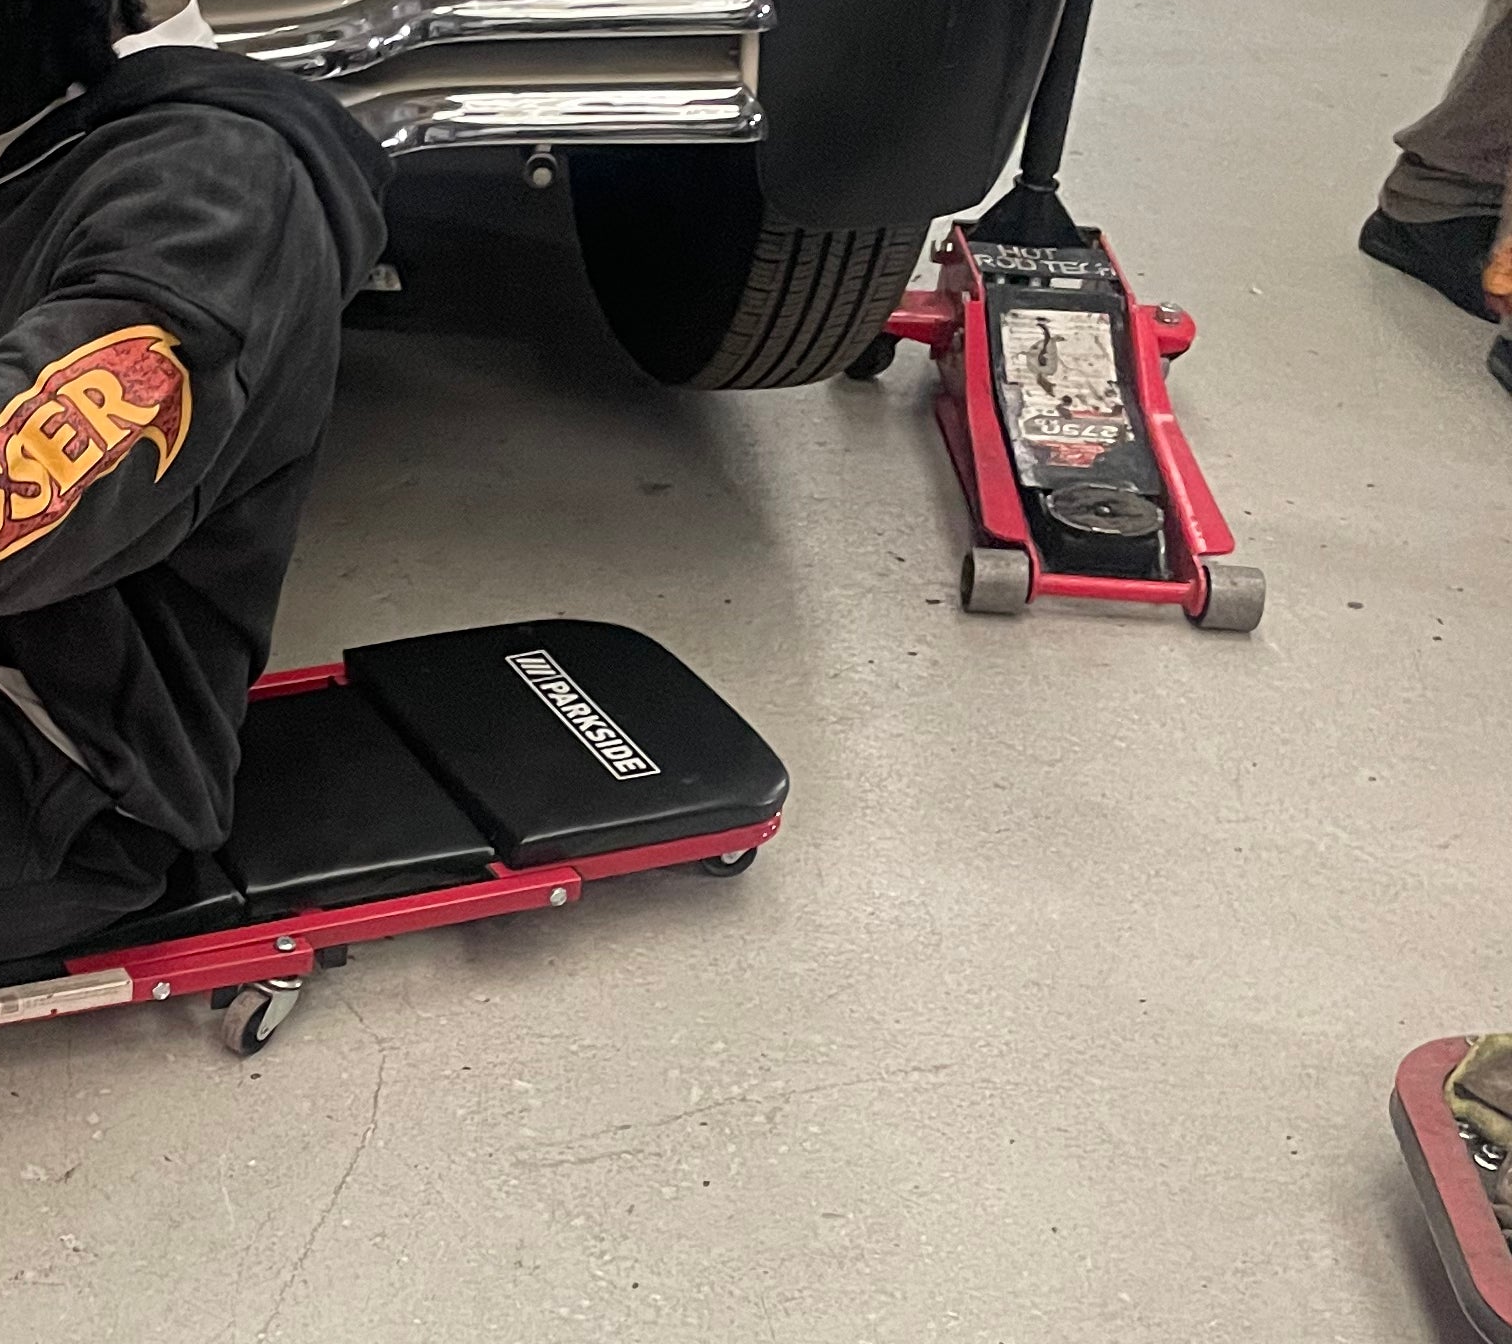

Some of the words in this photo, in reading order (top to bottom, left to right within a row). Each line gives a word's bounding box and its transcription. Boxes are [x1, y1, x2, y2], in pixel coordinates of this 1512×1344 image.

[997, 244, 1058, 260] HOT
[973, 254, 1037, 271] ROD
[540, 681, 647, 773] PARKSIDE
